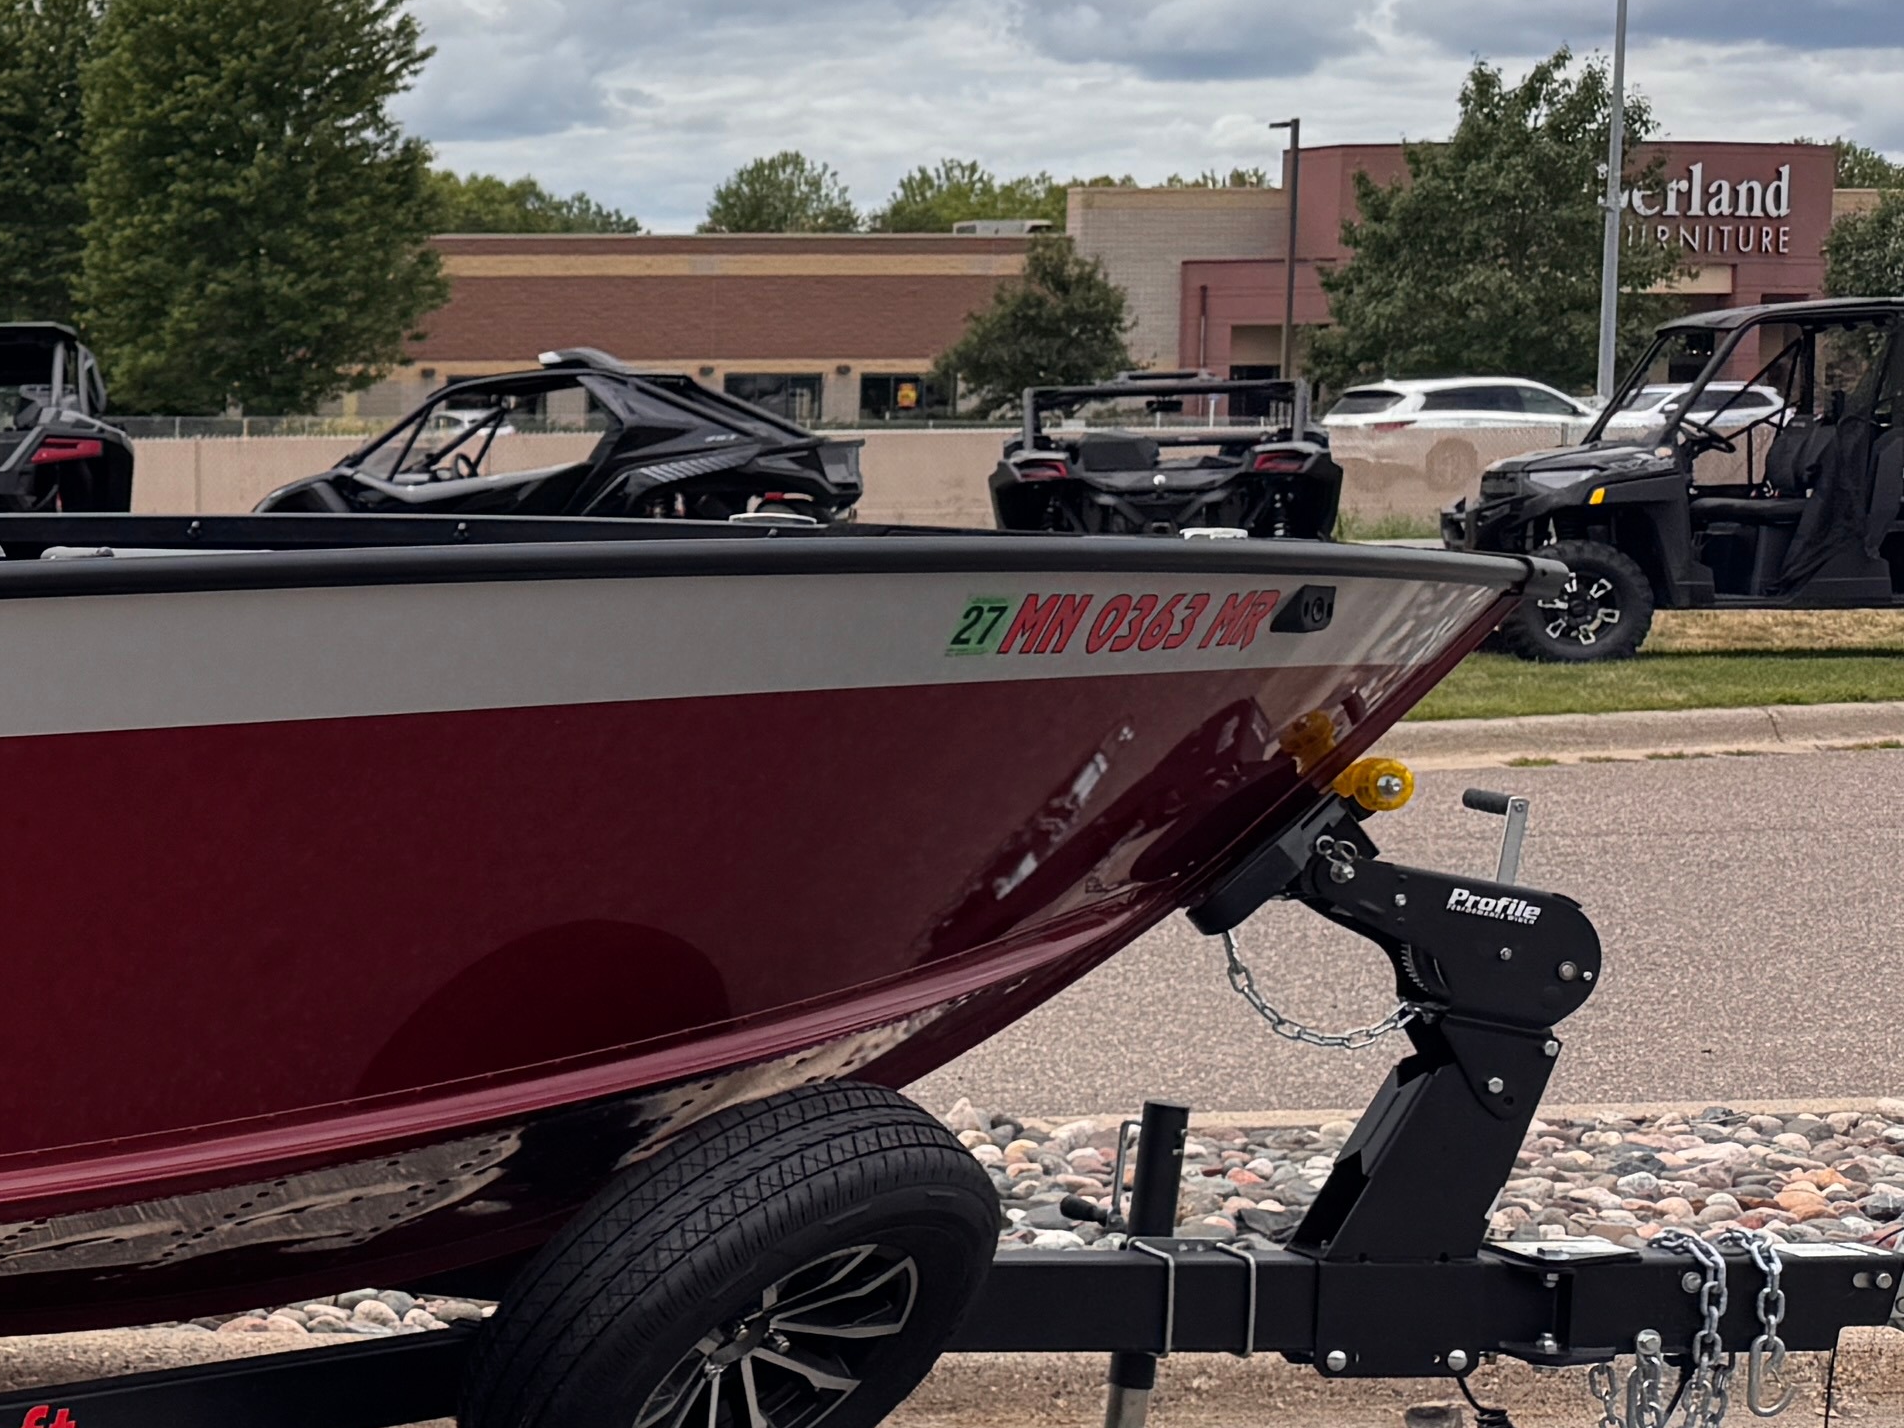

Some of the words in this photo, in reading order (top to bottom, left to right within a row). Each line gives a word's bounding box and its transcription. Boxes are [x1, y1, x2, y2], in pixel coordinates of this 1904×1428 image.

[1627, 225, 1790, 253] URNITURE
[950, 604, 1009, 646] 27
[996, 593, 1094, 655] MN
[1085, 592, 1211, 655] 0363
[1196, 589, 1282, 652] MR
[1446, 887, 1542, 921] Profile
